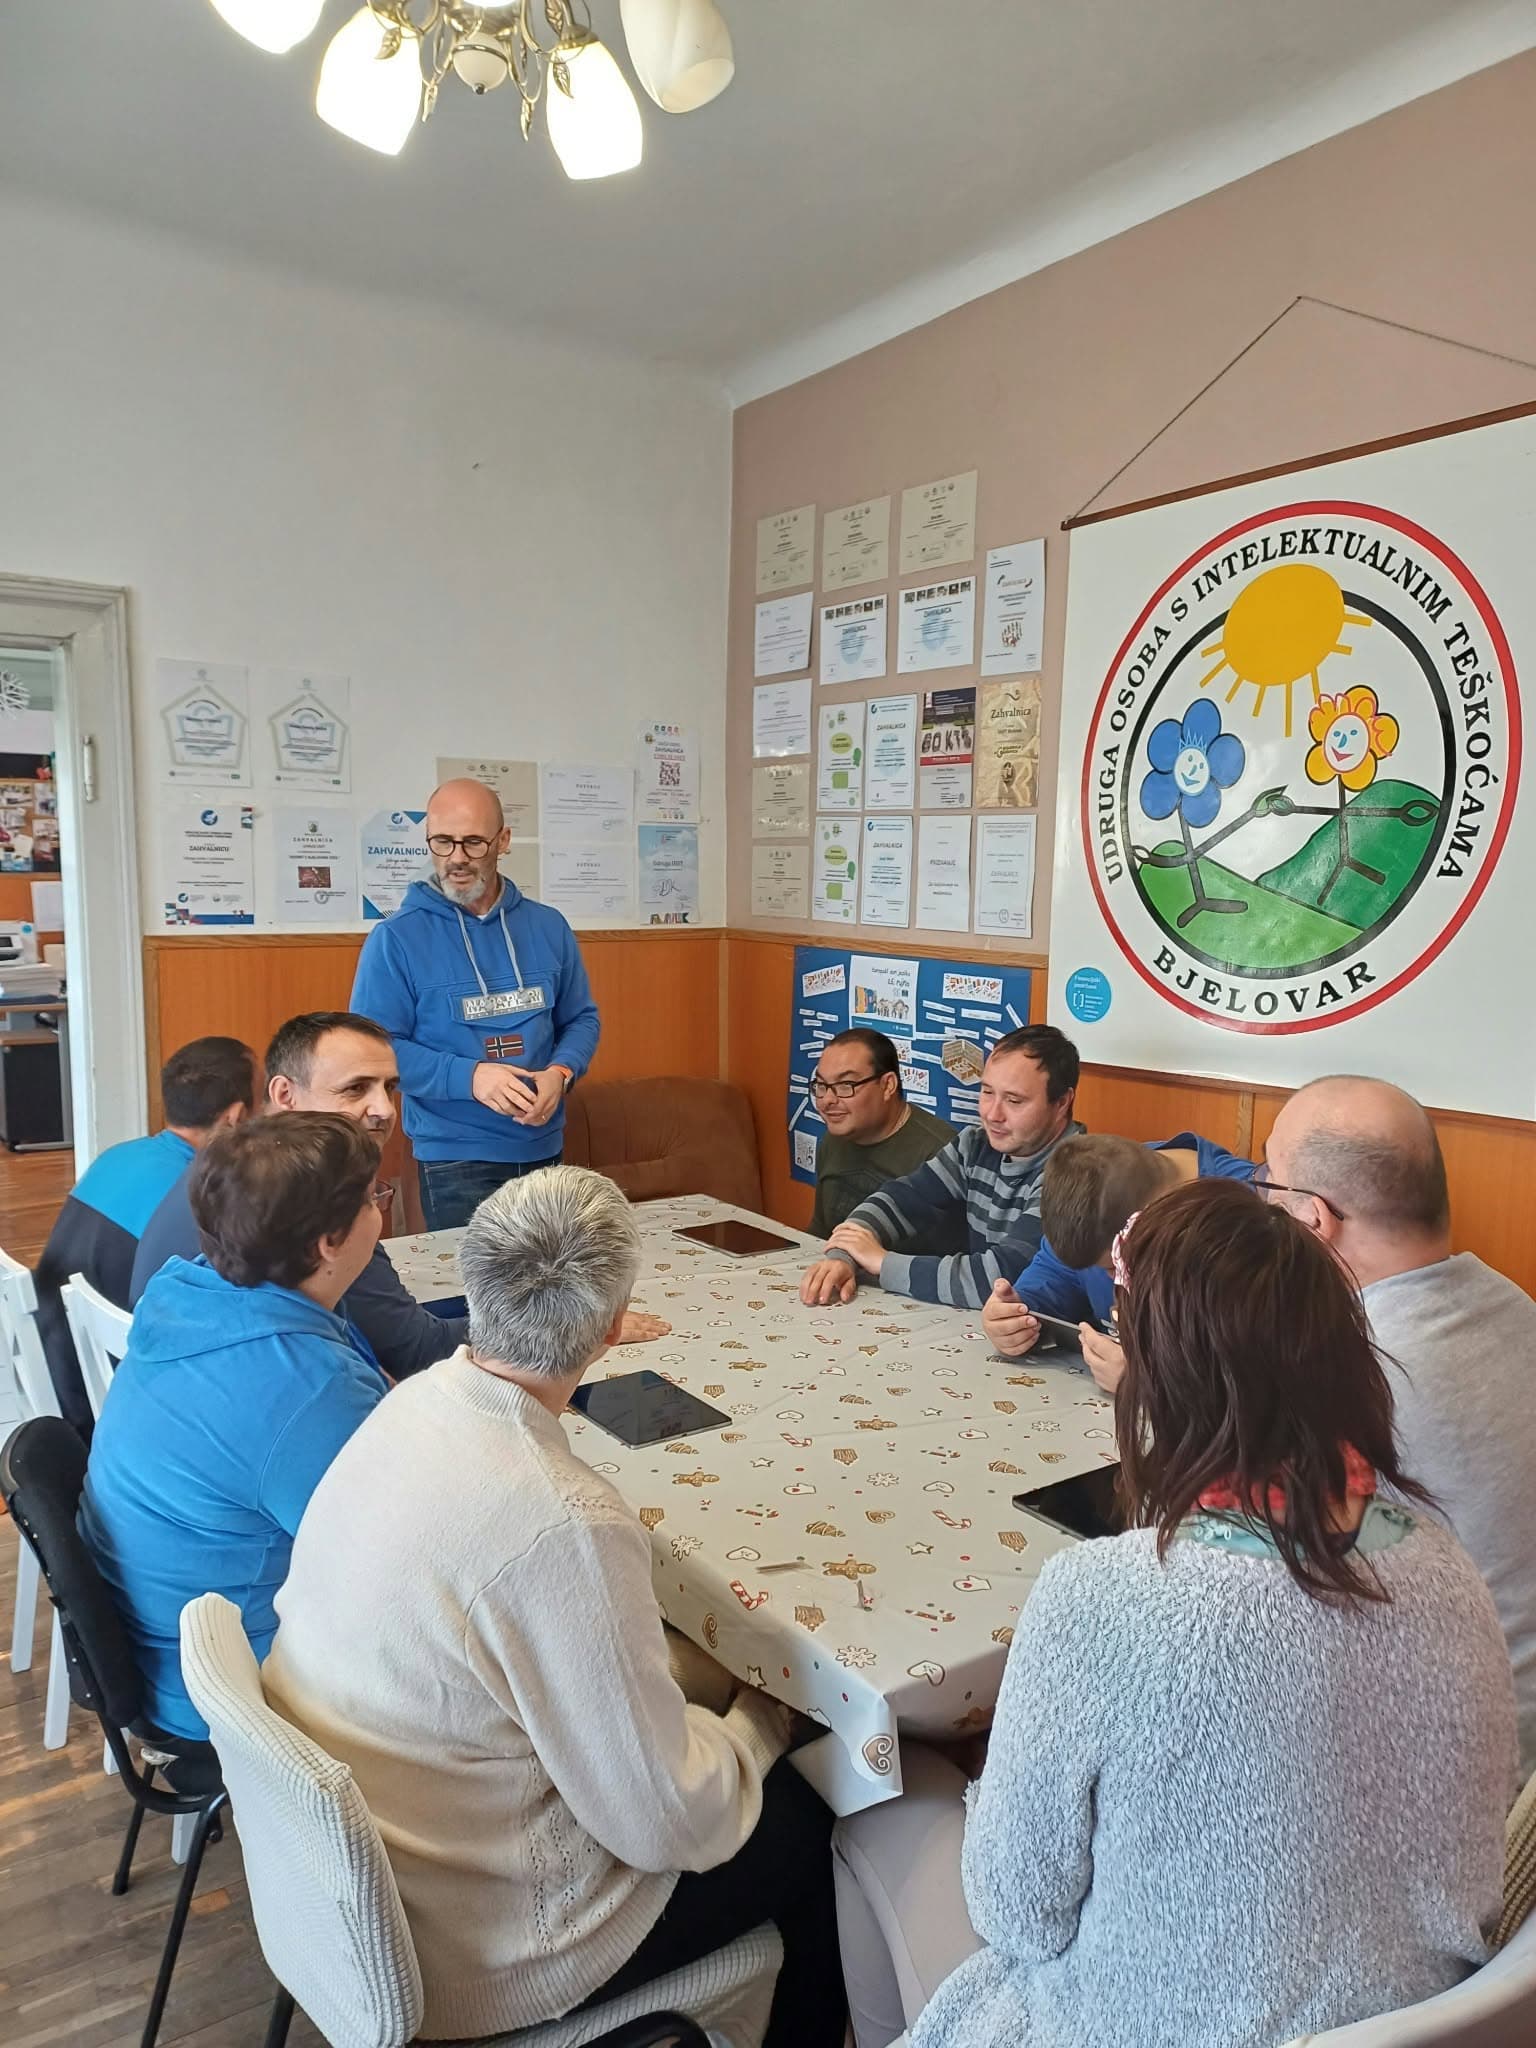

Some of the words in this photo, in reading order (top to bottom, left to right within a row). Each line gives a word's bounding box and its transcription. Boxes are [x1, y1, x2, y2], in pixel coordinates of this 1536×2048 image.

[1170, 596, 1189, 622] S
[1191, 528, 1453, 624] INTELEKTUALNIM
[991, 706, 1032, 719] Zahvalnica
[1110, 625, 1172, 732] OSOBA
[1436, 621, 1500, 879] TEŠKOĆAMA
[367, 846, 428, 856] ZAHVALNICU
[1098, 743, 1123, 885] UDRUGA
[1153, 944, 1377, 1016] BJELOVAR
